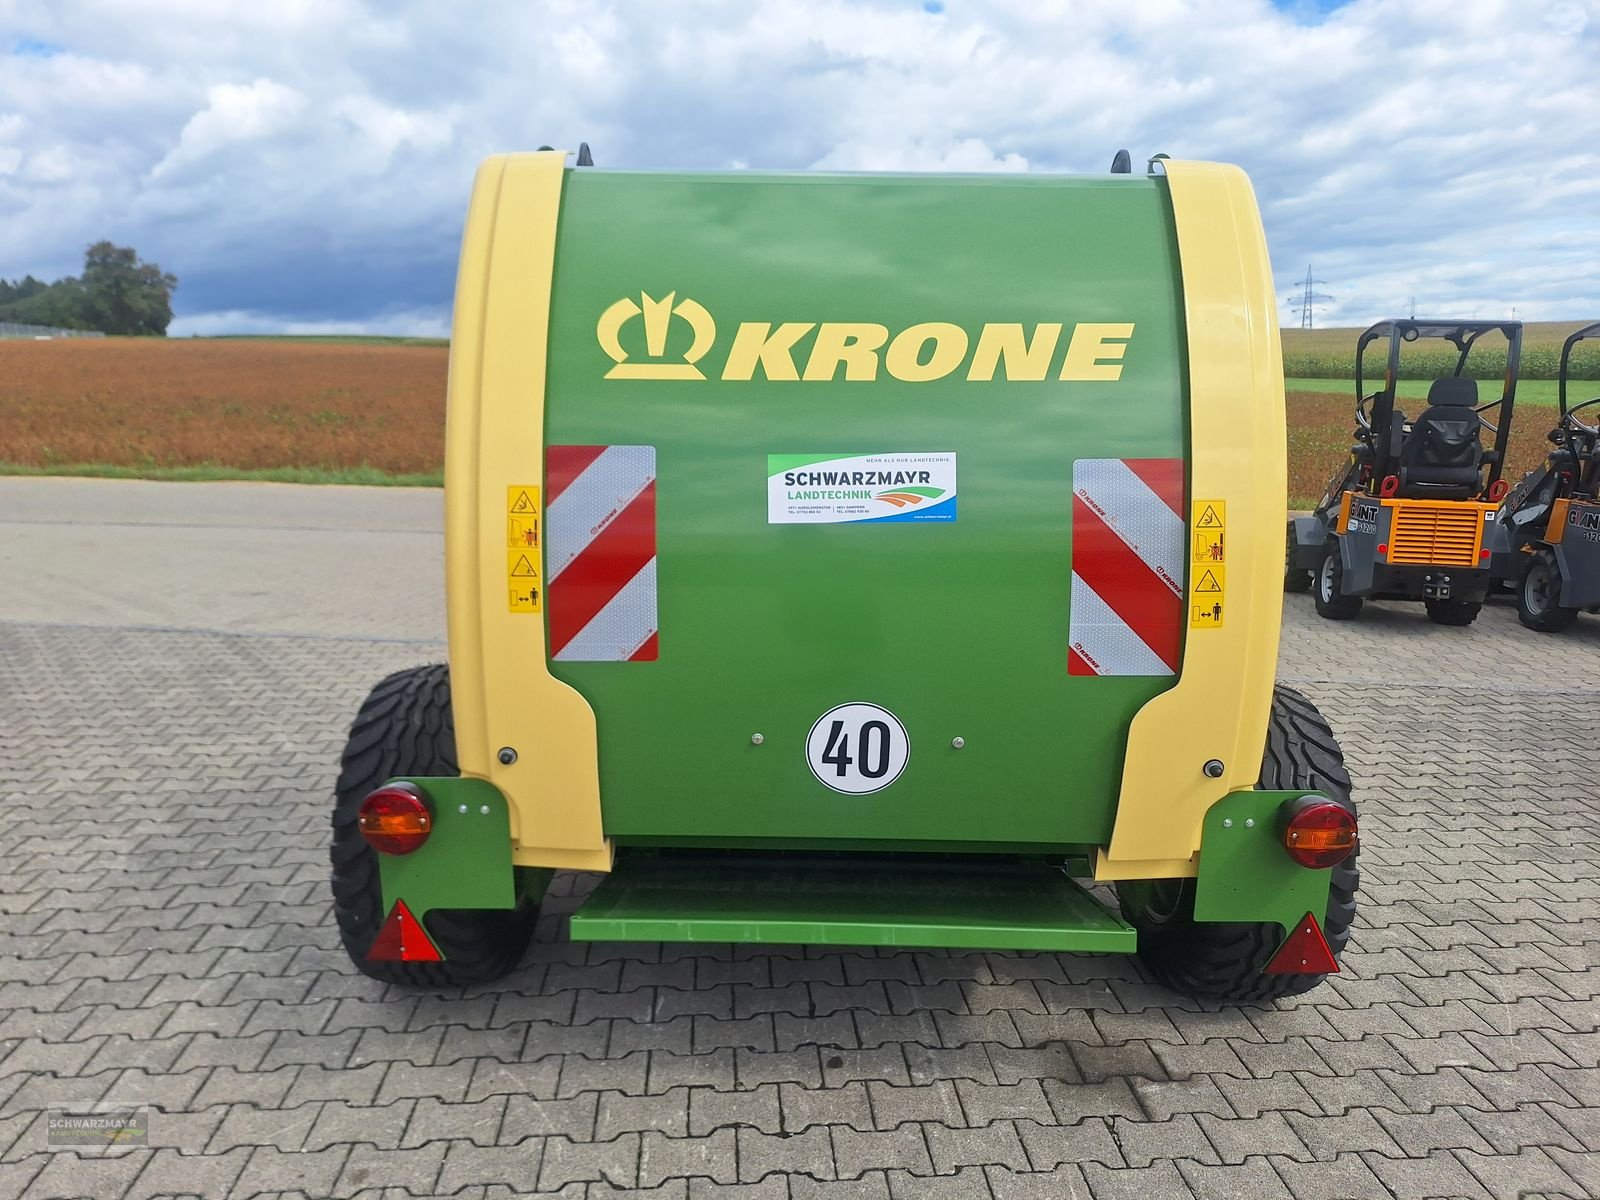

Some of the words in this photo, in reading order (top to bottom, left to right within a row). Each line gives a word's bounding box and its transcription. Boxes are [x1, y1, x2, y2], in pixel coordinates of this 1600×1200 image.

[721, 322, 1136, 382] KRONE
[784, 471, 931, 487] SCHWARZMAYR
[787, 490, 873, 500] LANDTECHNIK
[1079, 650, 1101, 669] KRONE
[821, 720, 891, 778] 40
